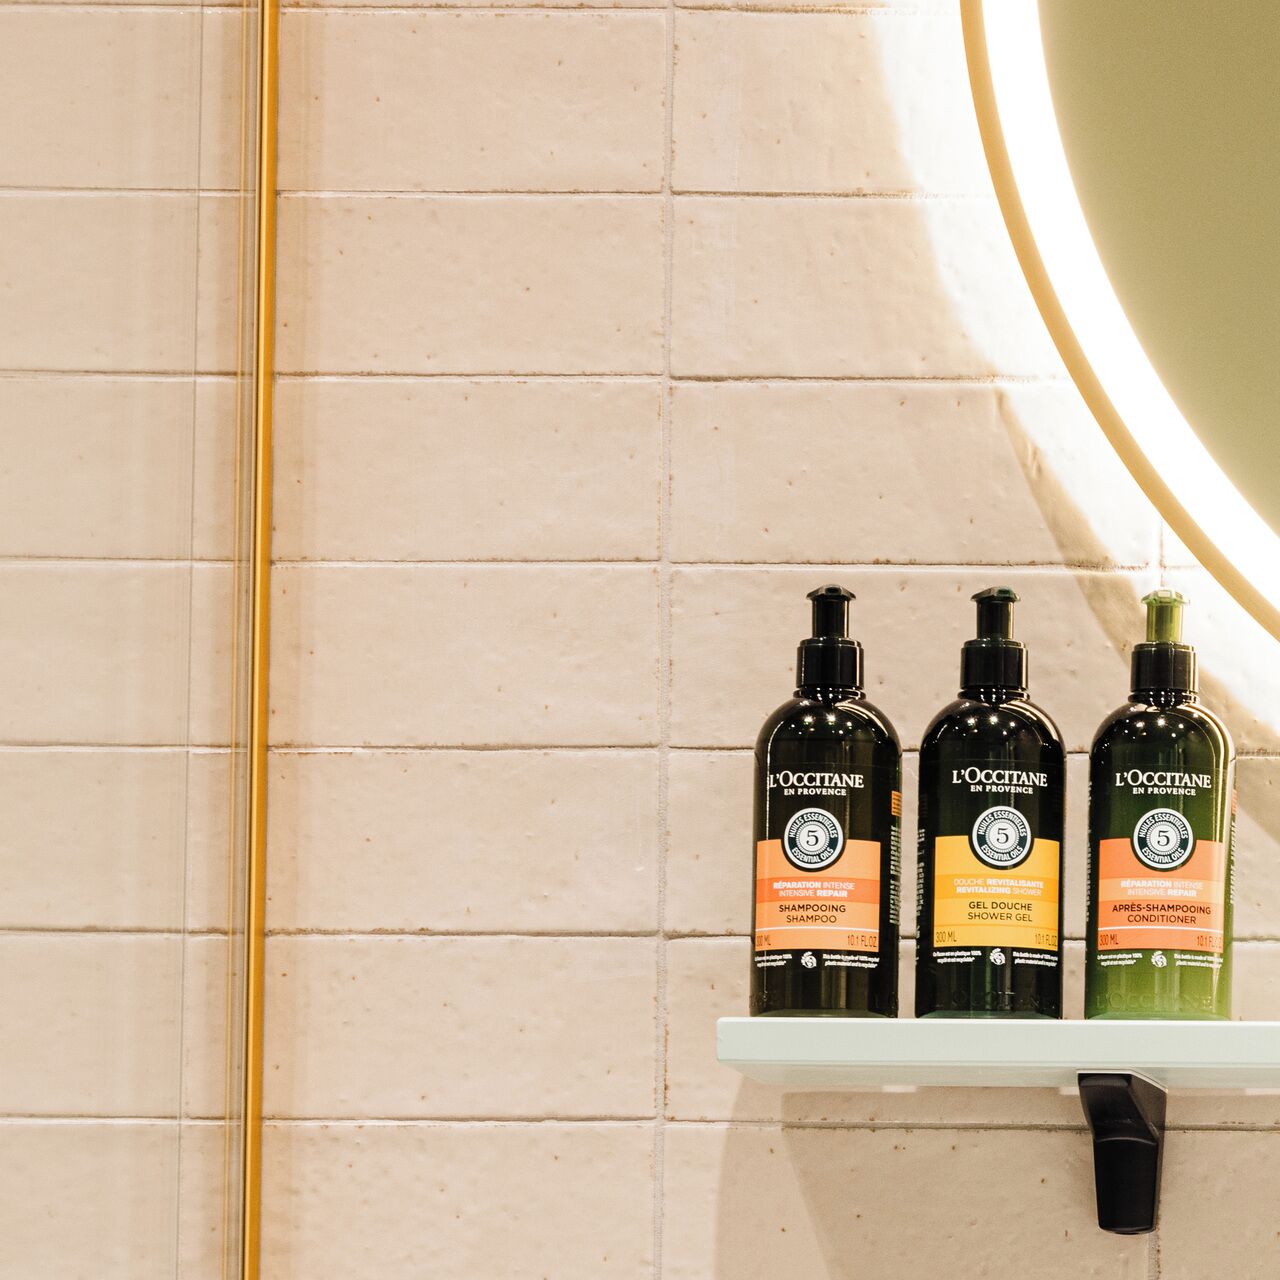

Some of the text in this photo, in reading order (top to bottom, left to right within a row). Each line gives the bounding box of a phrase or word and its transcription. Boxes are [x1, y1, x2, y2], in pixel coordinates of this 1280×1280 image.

[769, 771, 864, 788] L'OCCITANE
[952, 767, 1048, 787] L'OCCITANE
[1116, 769, 1212, 788] L'OCCITANE
[798, 788, 846, 796] PROVENCE
[986, 785, 1033, 794] PROVENCE
[1148, 788, 1196, 796] PROVENCE
[789, 812, 838, 838] HUILES ESSENTIELLES
[978, 810, 1027, 836] HUILES ESSENTIELLES
[1138, 813, 1188, 838] HUILES ESSENTIELLES
[806, 830, 819, 846] 5
[996, 828, 1009, 844] 5
[1157, 831, 1170, 846] 5
[792, 847, 834, 862] ESSENTIAL OILS
[981, 845, 1023, 861] ESSENTIAL OILS
[1142, 848, 1184, 863] ESSENTIAL OILS
[822, 882, 855, 890] INTENSE
[816, 890, 848, 898] REPAIR
[779, 904, 846, 912] SHAMPOOING
[991, 902, 1032, 911] DOUCHE
[1112, 902, 1211, 914] APRÈS-SHAMPOOING
[786, 915, 837, 923] SHAMPOO
[968, 912, 1032, 922] SHOWER GEL
[1128, 915, 1196, 924] CONDITIONER
[948, 932, 957, 942] ML
[1110, 934, 1118, 945] ML
